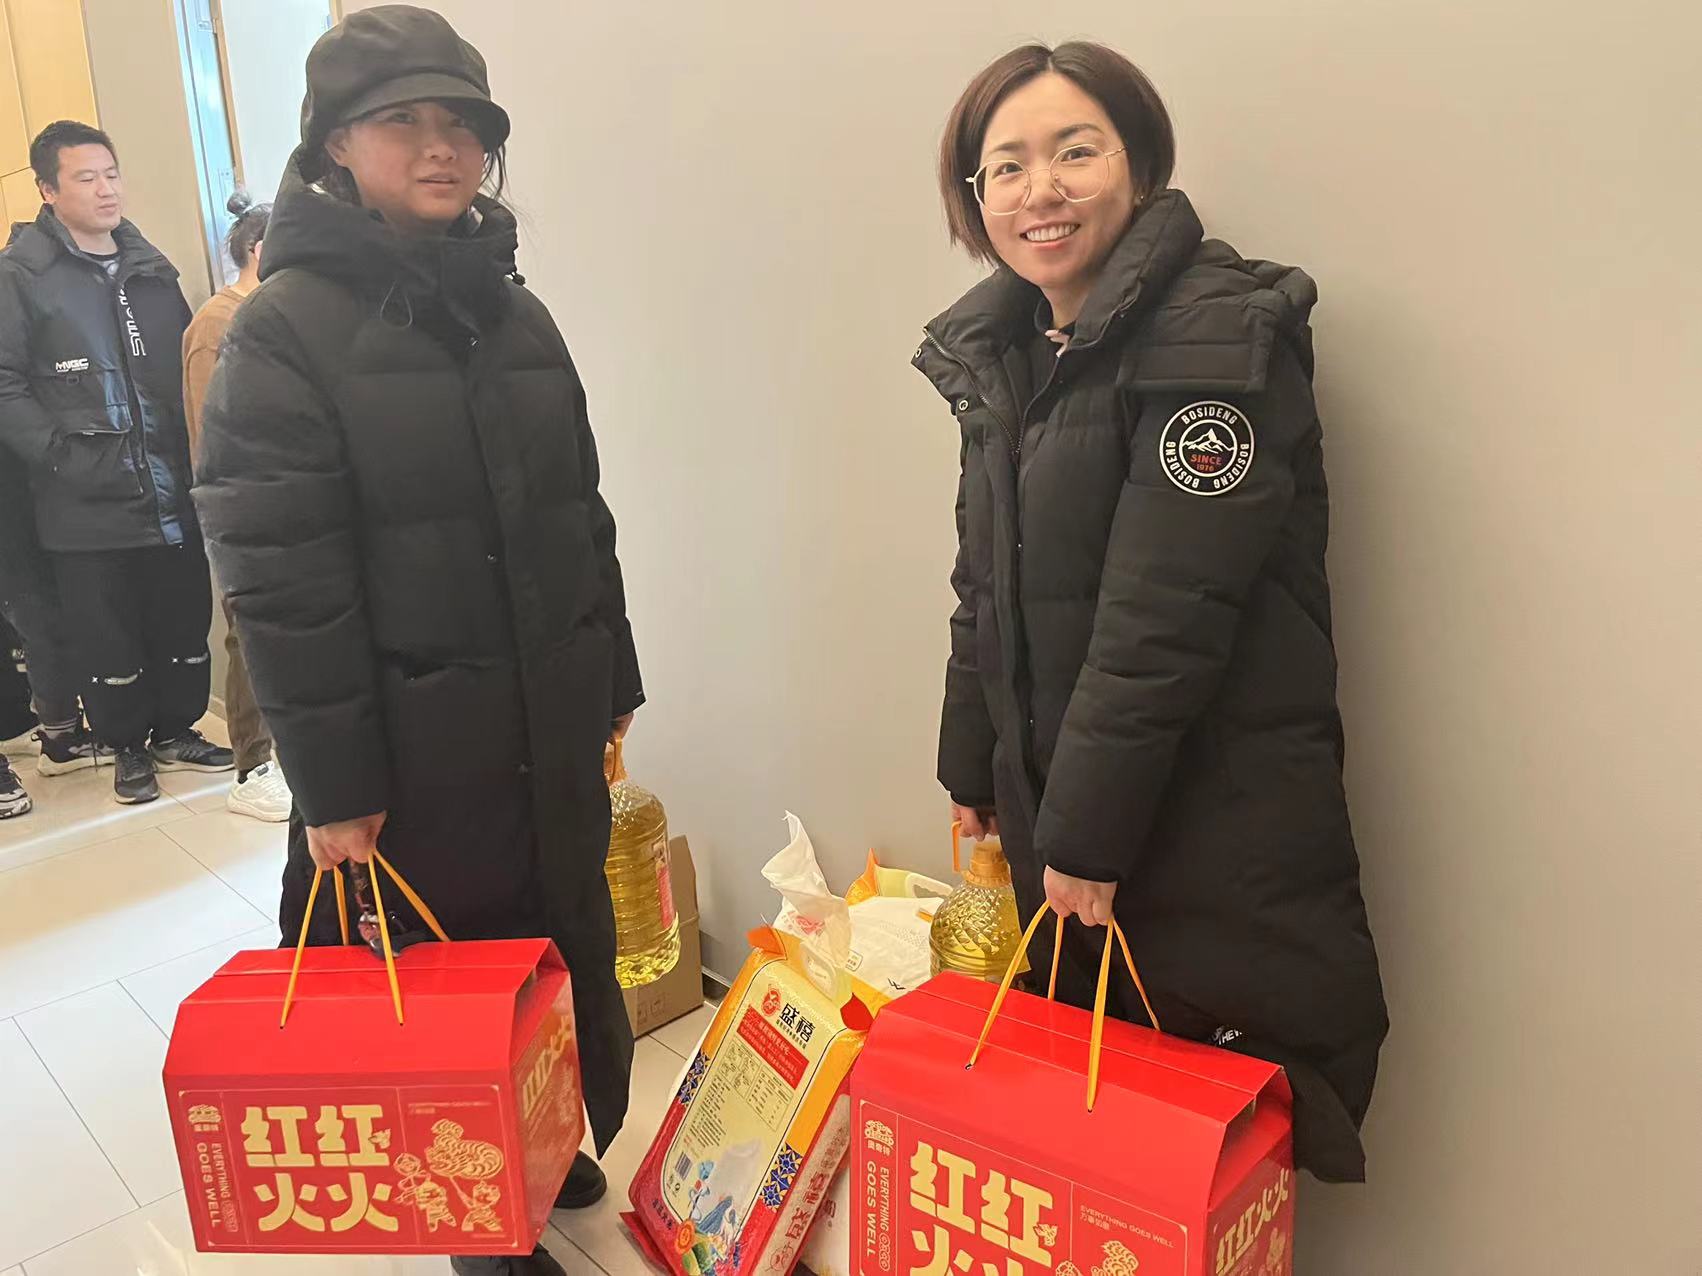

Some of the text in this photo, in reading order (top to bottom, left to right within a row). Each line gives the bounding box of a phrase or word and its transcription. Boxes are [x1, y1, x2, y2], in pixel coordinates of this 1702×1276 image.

[1181, 407, 1238, 425] BOSIDENG
[1165, 441, 1200, 489] BOSIDENG
[1190, 454, 1223, 466] SINCE
[1213, 443, 1250, 489] BOSIDENG
[240, 1104, 391, 1168] 红红
[197, 1142, 213, 1183] GOES
[205, 1188, 221, 1228] WELL
[211, 1143, 231, 1199] EVERYTHING
[879, 1166, 890, 1232] EVERYTHING
[252, 1172, 399, 1232] 火火
[866, 1160, 877, 1257] GOES WELL
[910, 1141, 1054, 1268] 红红
[1080, 1205, 1175, 1248] EVERYTHING GOES WELL
